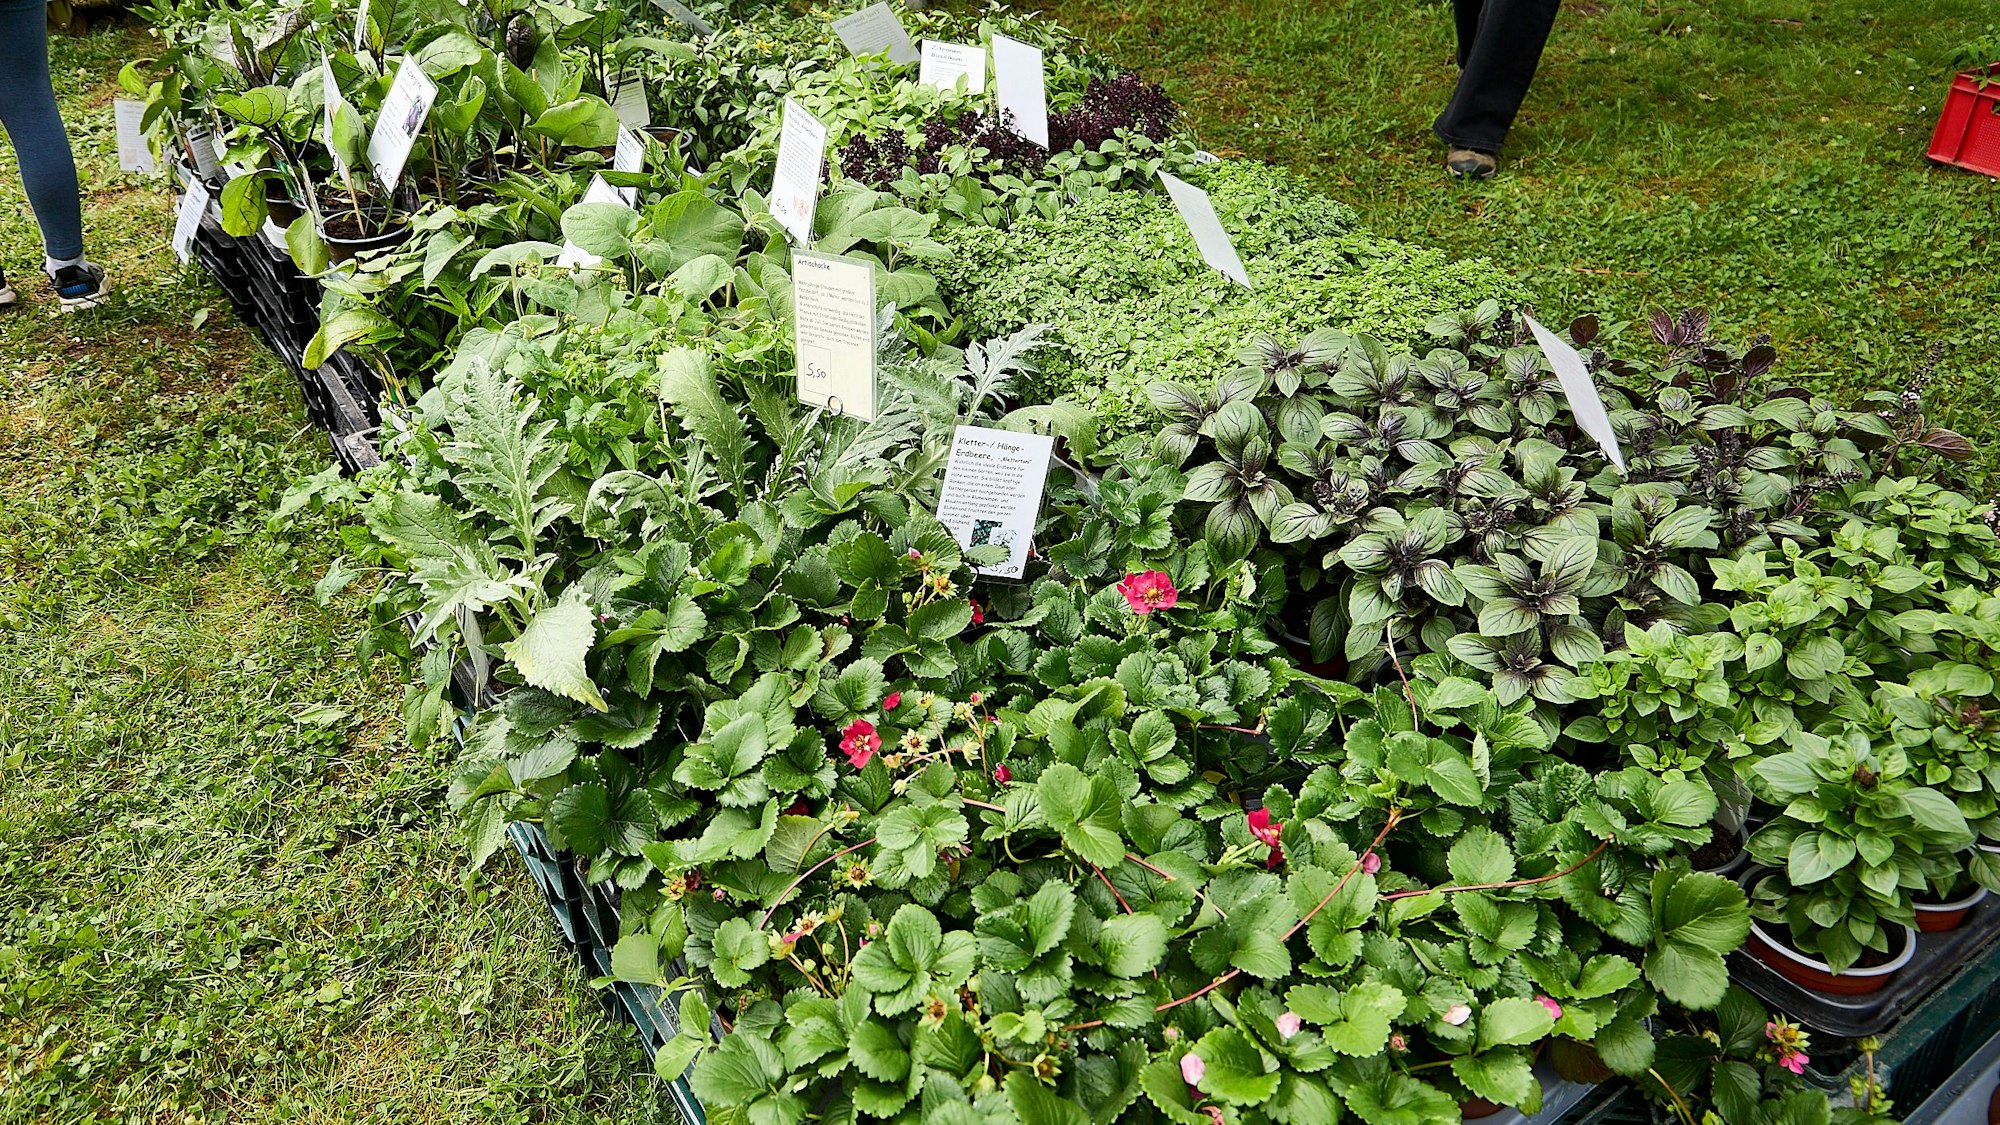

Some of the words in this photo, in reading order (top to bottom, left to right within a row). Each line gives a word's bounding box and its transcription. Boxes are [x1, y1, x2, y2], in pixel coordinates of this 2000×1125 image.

[931, 45, 961, 54] Zitronen
[931, 52, 963, 62] Basilikum
[798, 260, 830, 270] Artischocke
[806, 363, 826, 378] 5,50
[997, 442, 1024, 453] Hänge-
[956, 449, 993, 461] Erdbeere,
[979, 489, 1009, 497] hochgebunden
